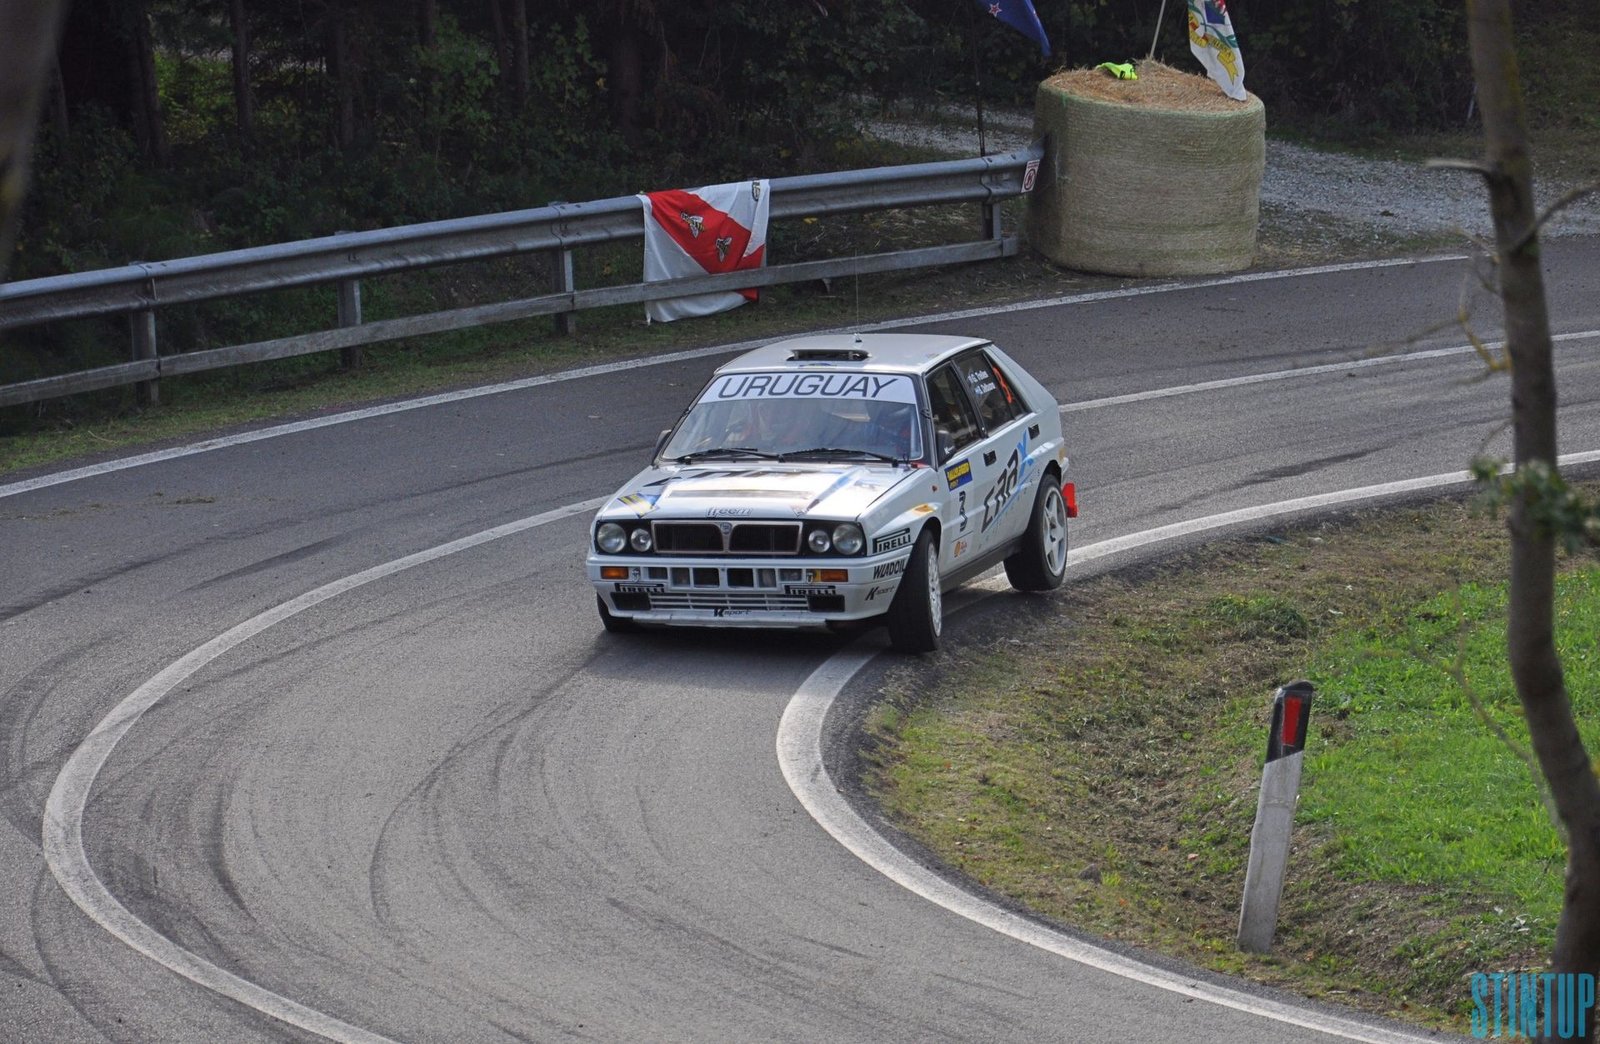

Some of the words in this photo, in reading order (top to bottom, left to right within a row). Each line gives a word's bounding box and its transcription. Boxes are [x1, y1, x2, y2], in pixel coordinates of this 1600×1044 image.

[717, 374, 899, 399] URUGUAY
[958, 490, 968, 533] 3
[872, 528, 911, 554] PIRELLI
[614, 582, 665, 593] PIRELLI
[784, 585, 836, 595] PIRELLI
